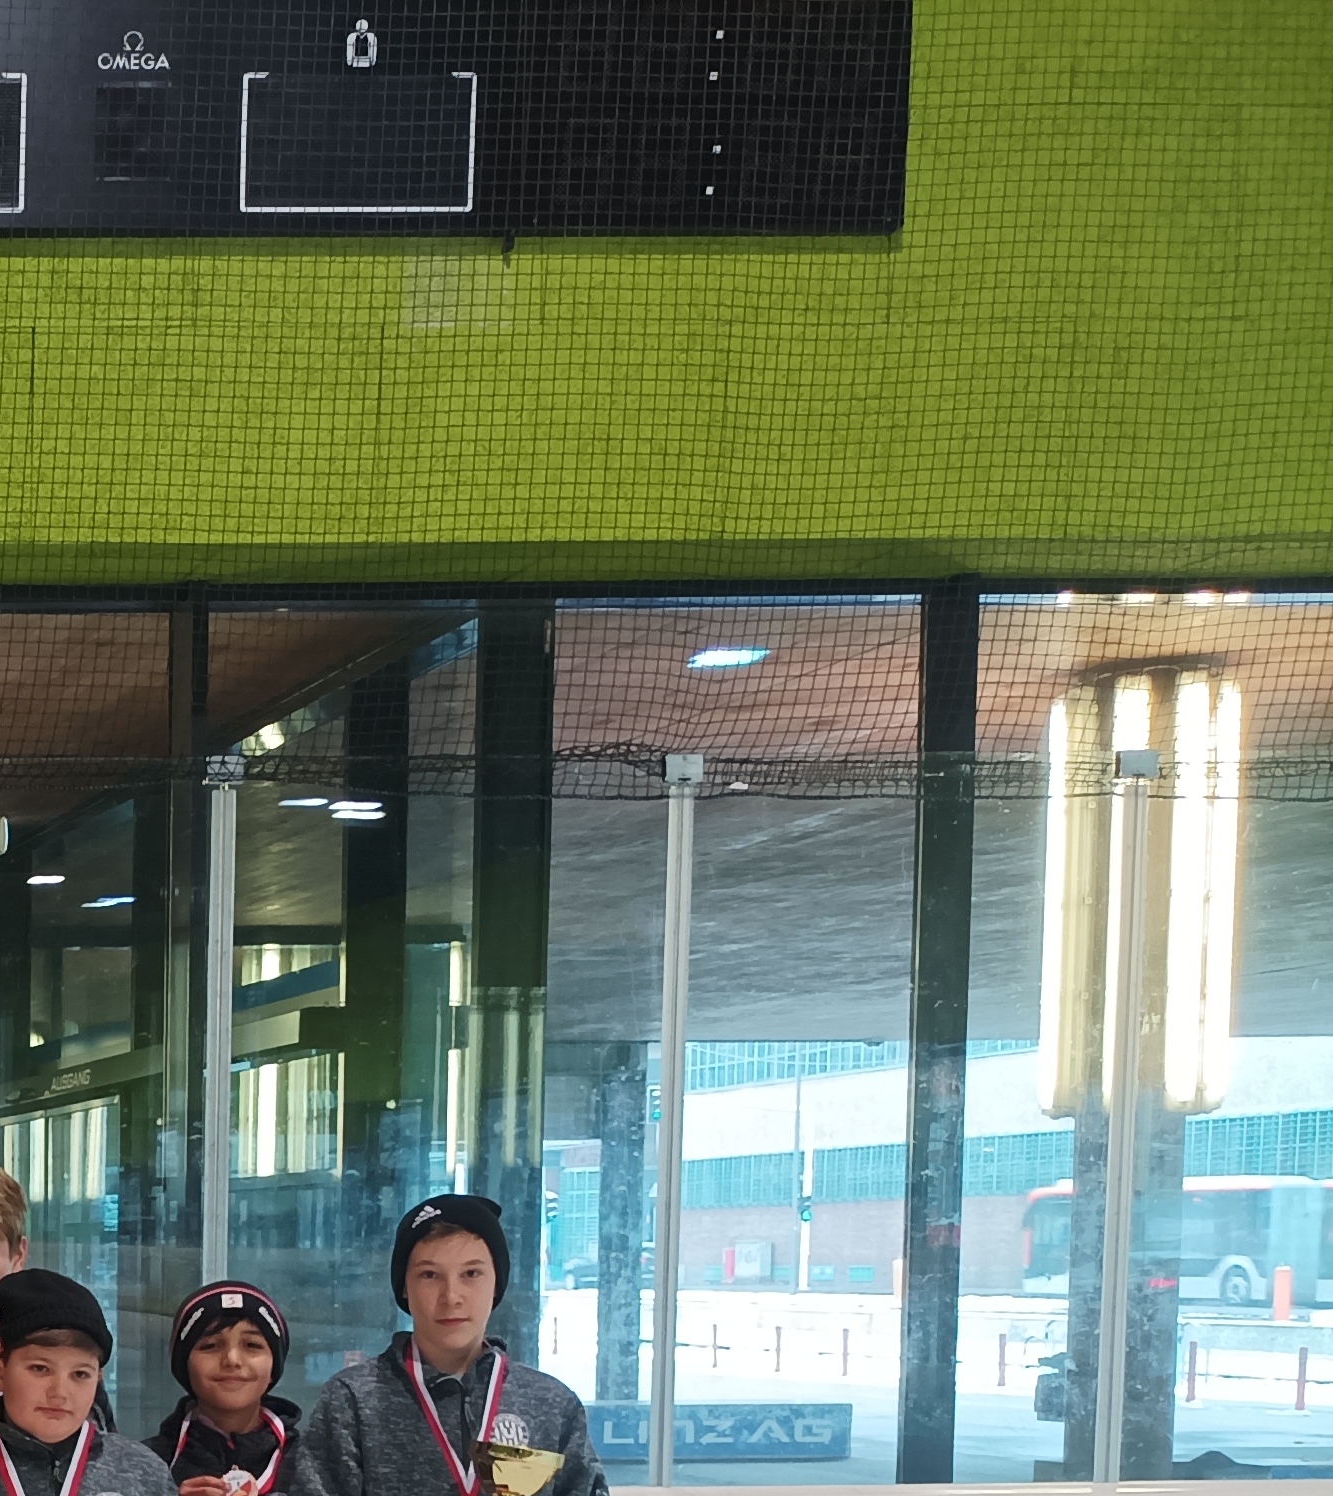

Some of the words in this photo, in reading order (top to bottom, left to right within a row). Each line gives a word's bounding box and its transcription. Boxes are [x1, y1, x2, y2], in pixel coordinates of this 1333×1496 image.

[97, 53, 171, 70] OMEGA
[51, 1069, 91, 1091] AUSGANG
[746, 1419, 833, 1444] AG
